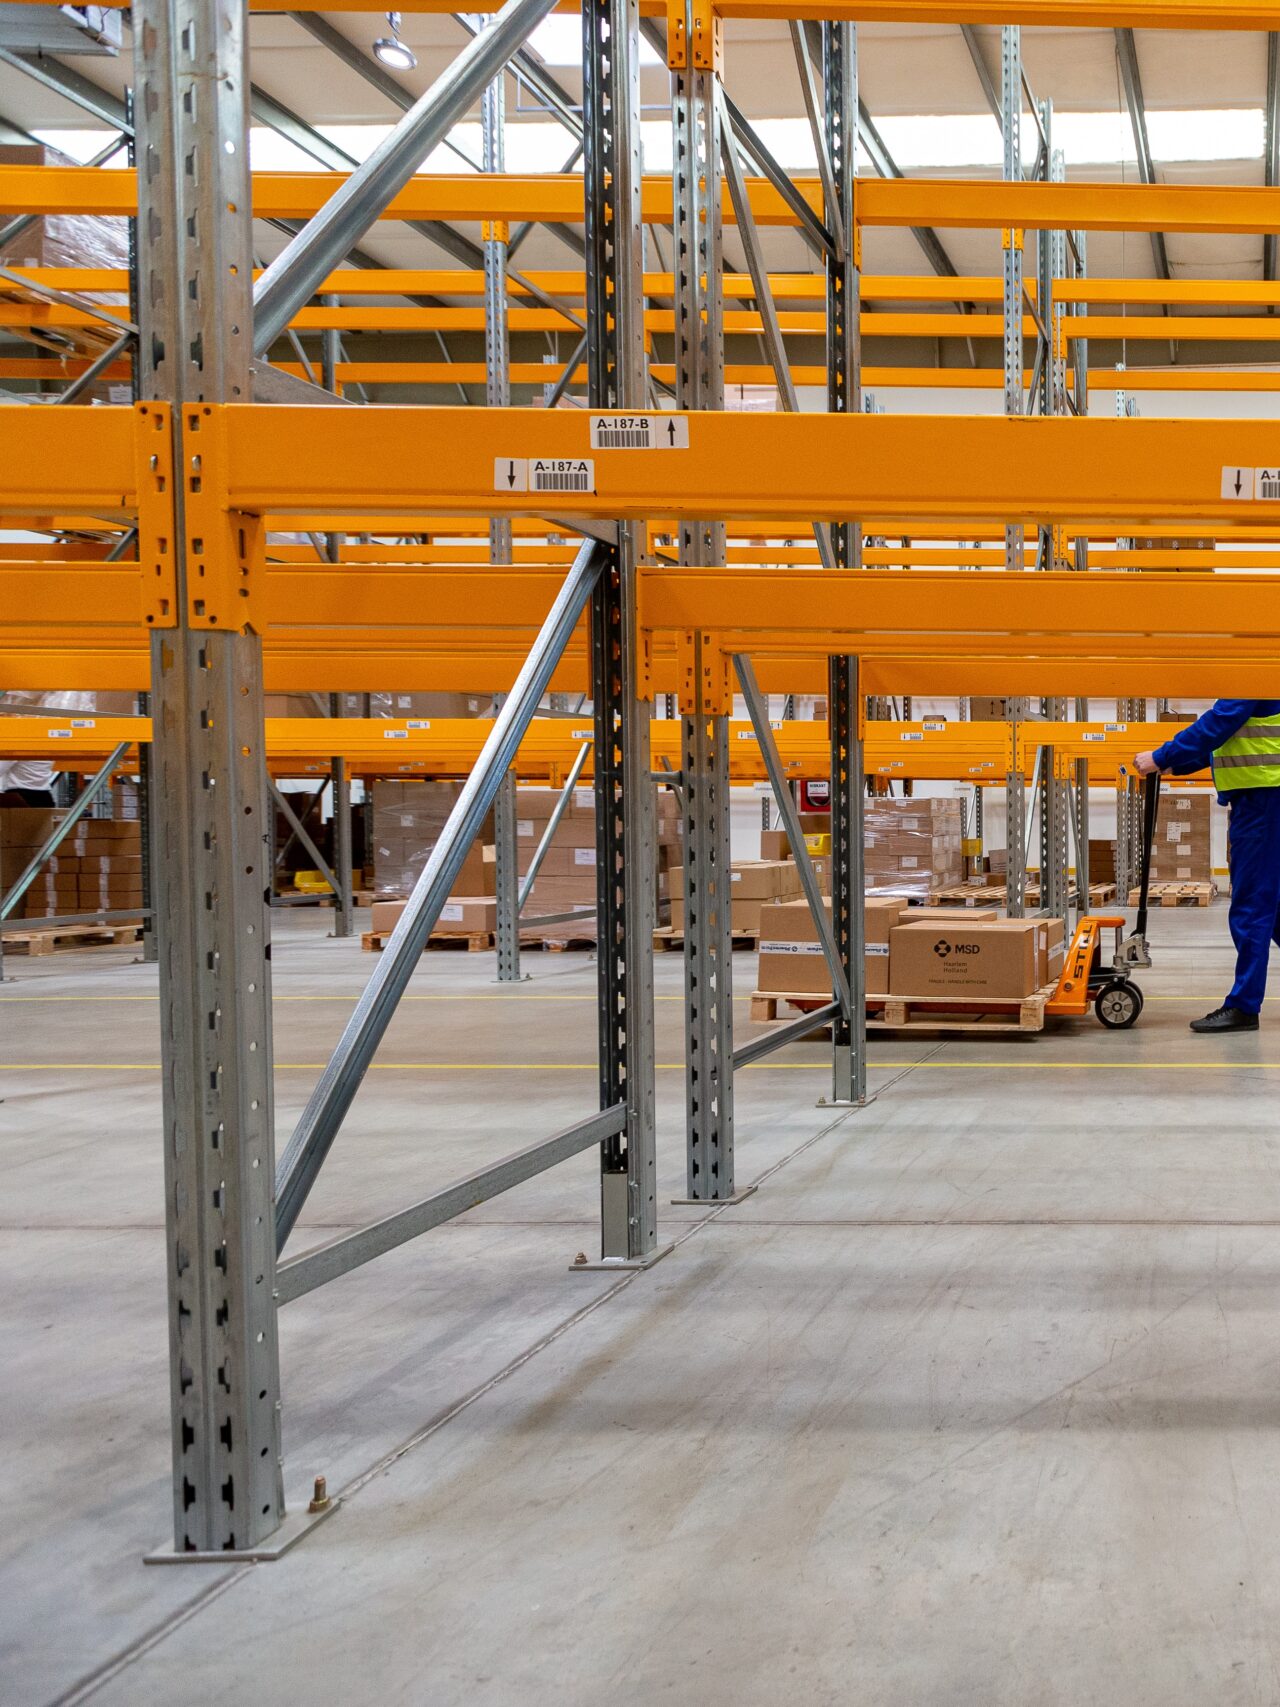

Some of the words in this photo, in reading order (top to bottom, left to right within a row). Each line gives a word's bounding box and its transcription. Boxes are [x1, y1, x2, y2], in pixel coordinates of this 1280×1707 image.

[597, 418, 649, 429] A-187-B
[534, 461, 588, 472] A-187-A
[955, 944, 980, 955] MSD
[1073, 924, 1093, 979] STILL
